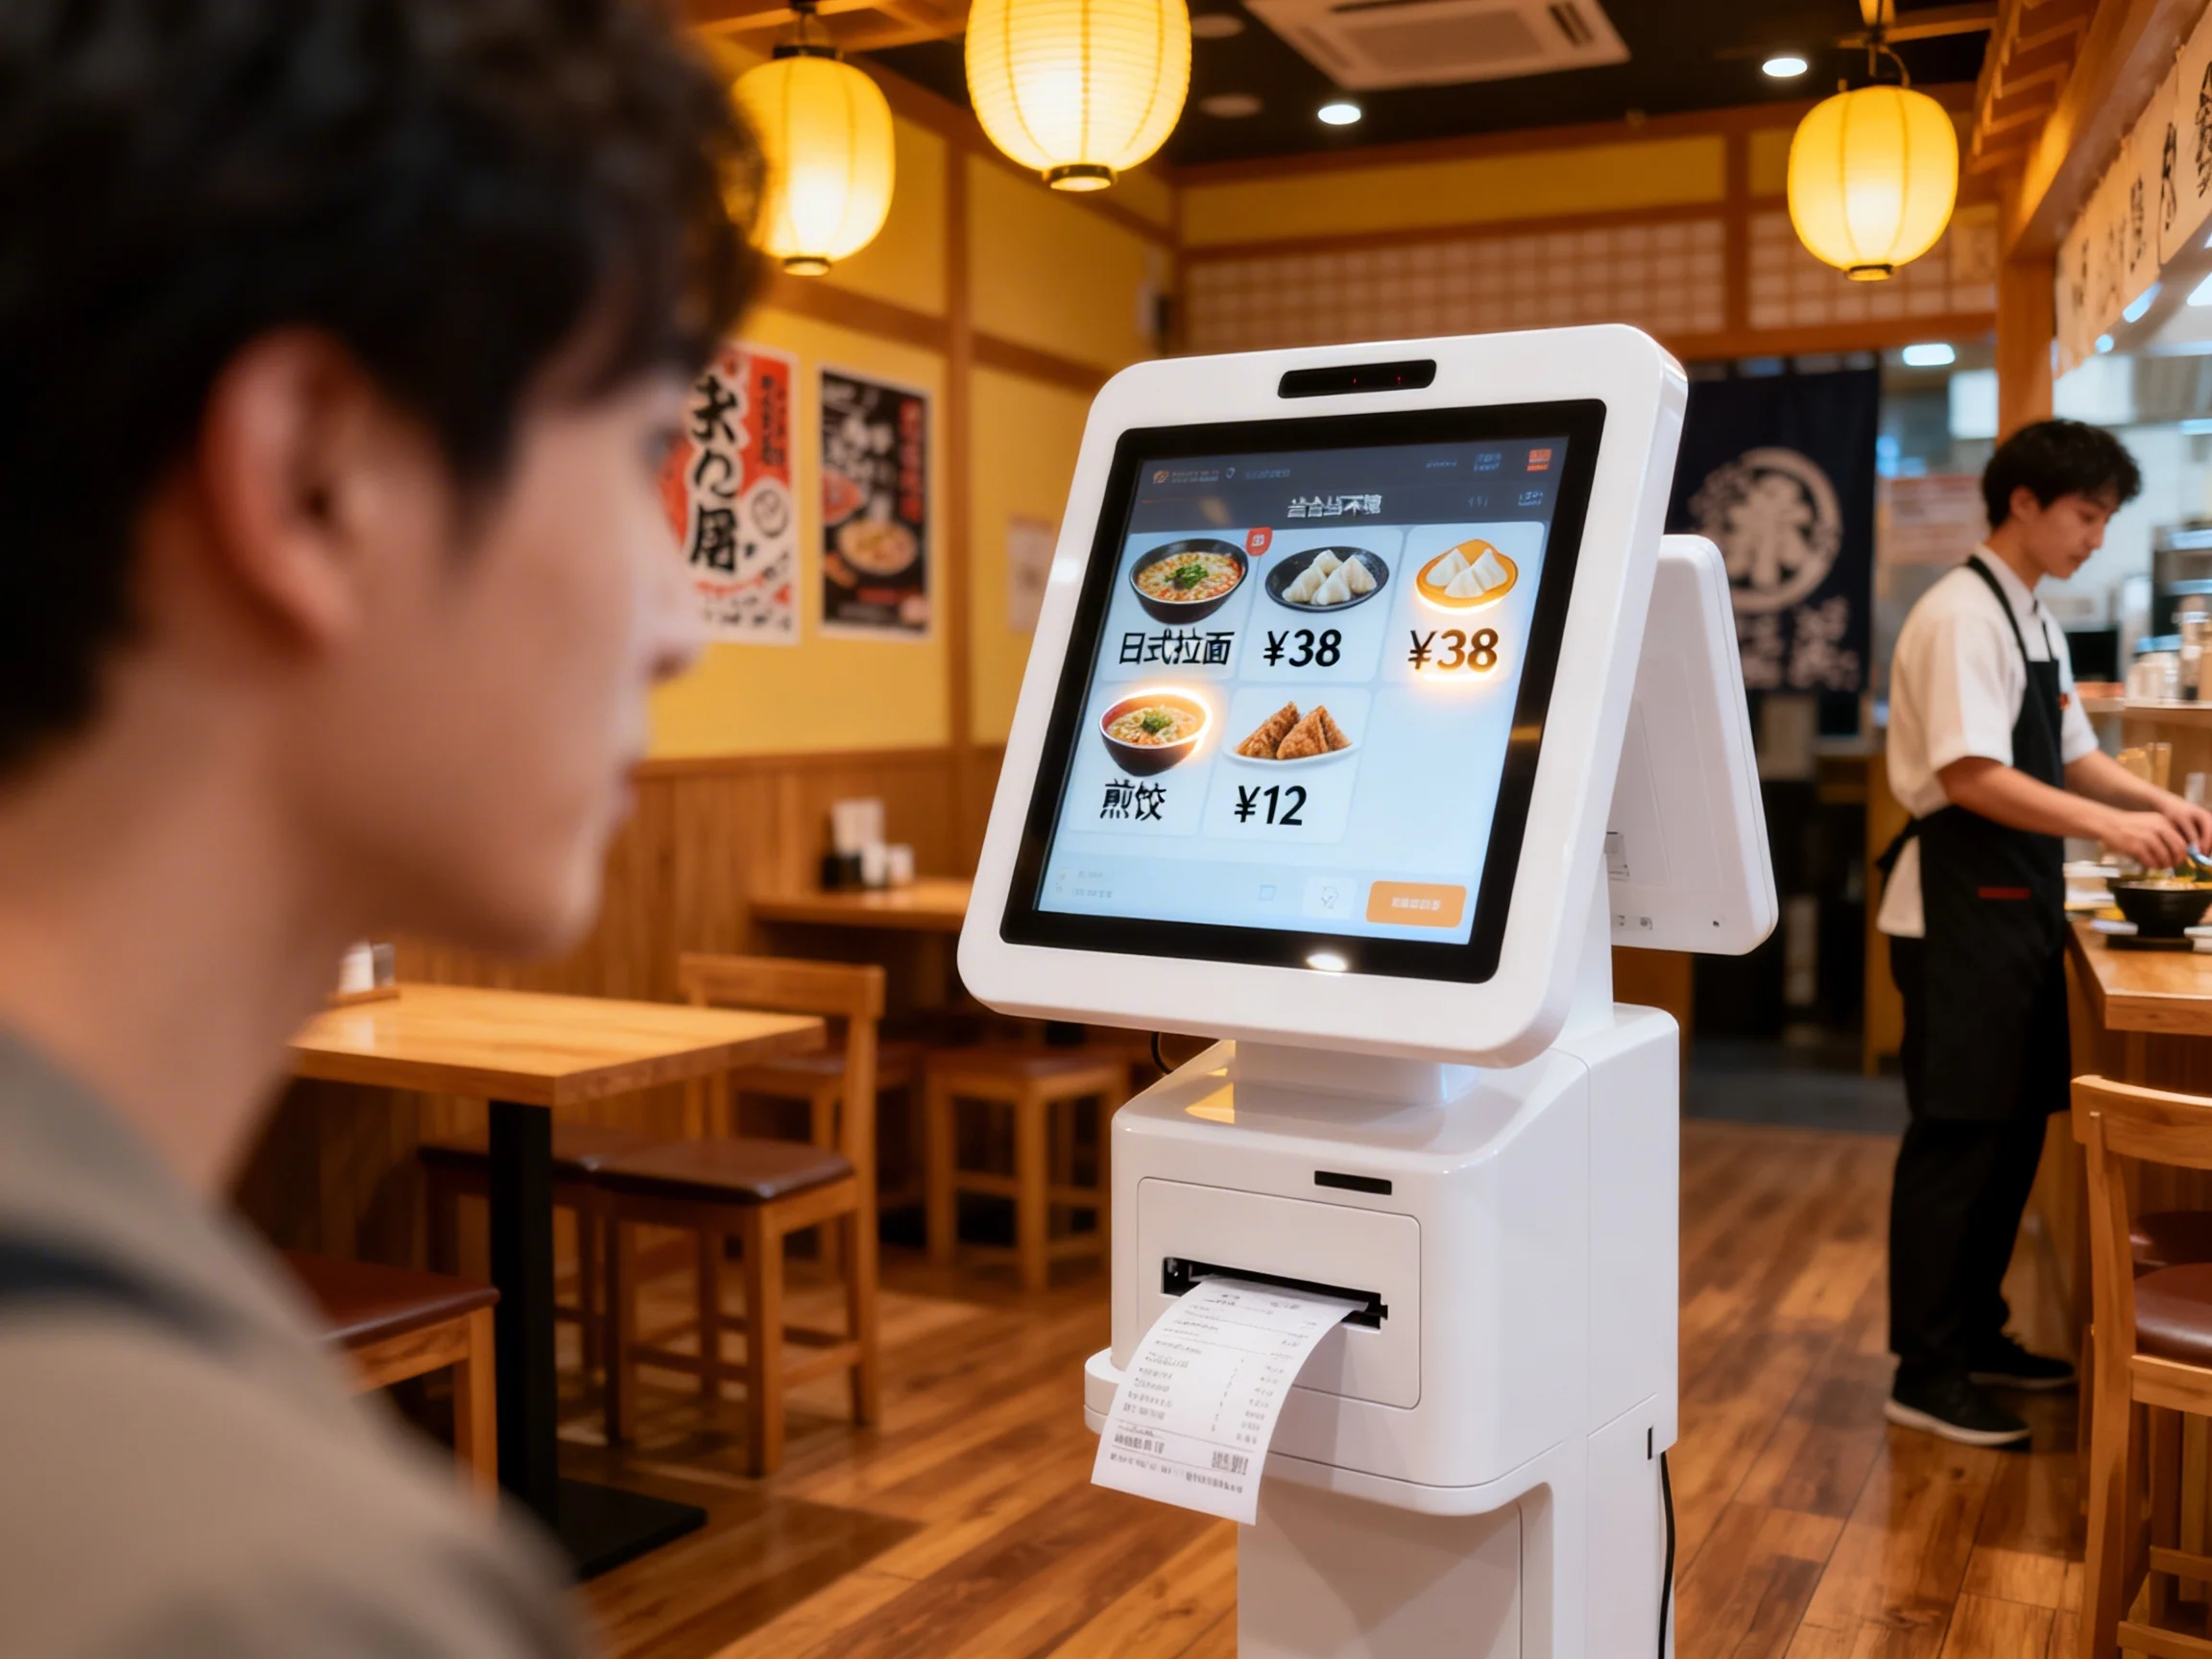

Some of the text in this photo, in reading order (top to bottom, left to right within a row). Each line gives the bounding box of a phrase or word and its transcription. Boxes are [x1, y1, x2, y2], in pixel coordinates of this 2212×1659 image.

[1118, 627, 1235, 665] 日式拉面
[1263, 629, 1342, 667] ¥38
[1407, 628, 1499, 672] ¥38
[1099, 779, 1166, 821] 煎饺
[1234, 784, 1307, 826] ¥12
